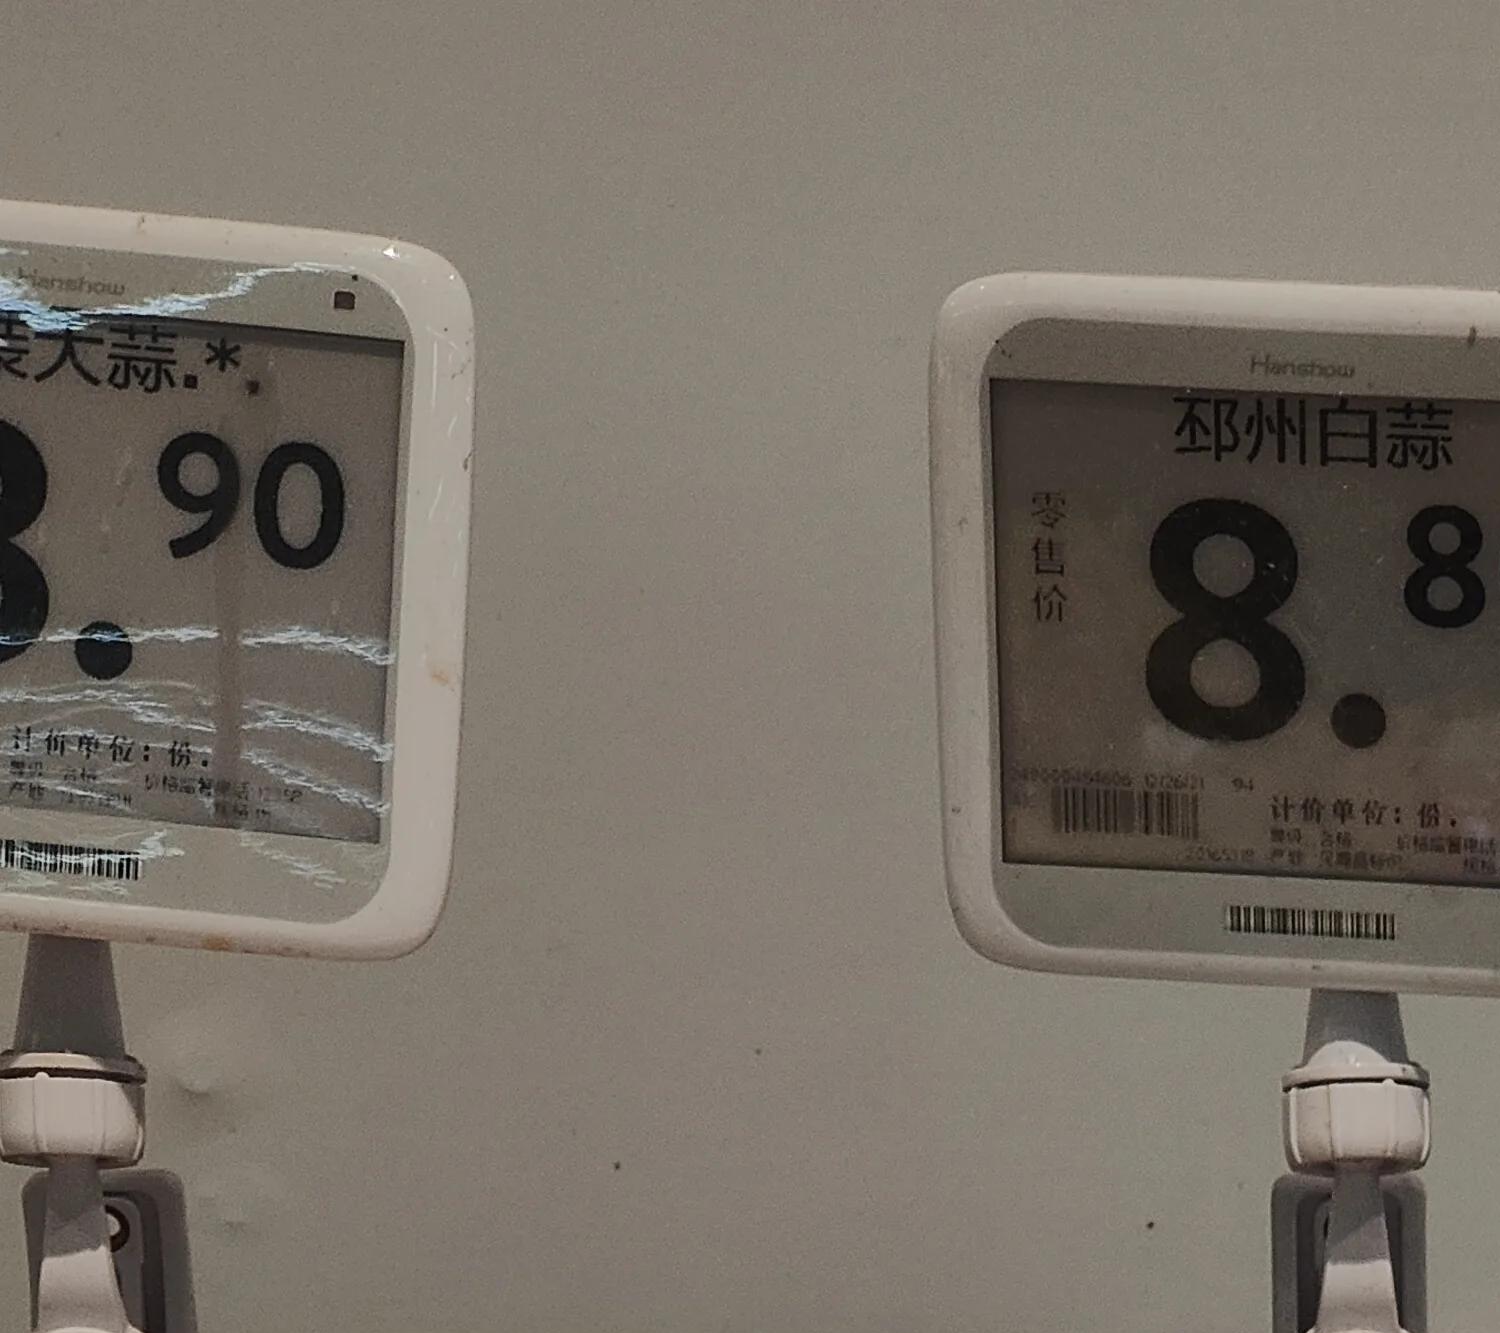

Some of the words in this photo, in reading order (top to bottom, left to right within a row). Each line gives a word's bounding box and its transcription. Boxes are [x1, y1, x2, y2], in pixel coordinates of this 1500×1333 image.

[1250, 353, 1355, 381] Hanshow
[1173, 398, 1454, 470] 邳州白蒜
[156, 430, 345, 571] 90
[1031, 491, 1067, 623] 零售价
